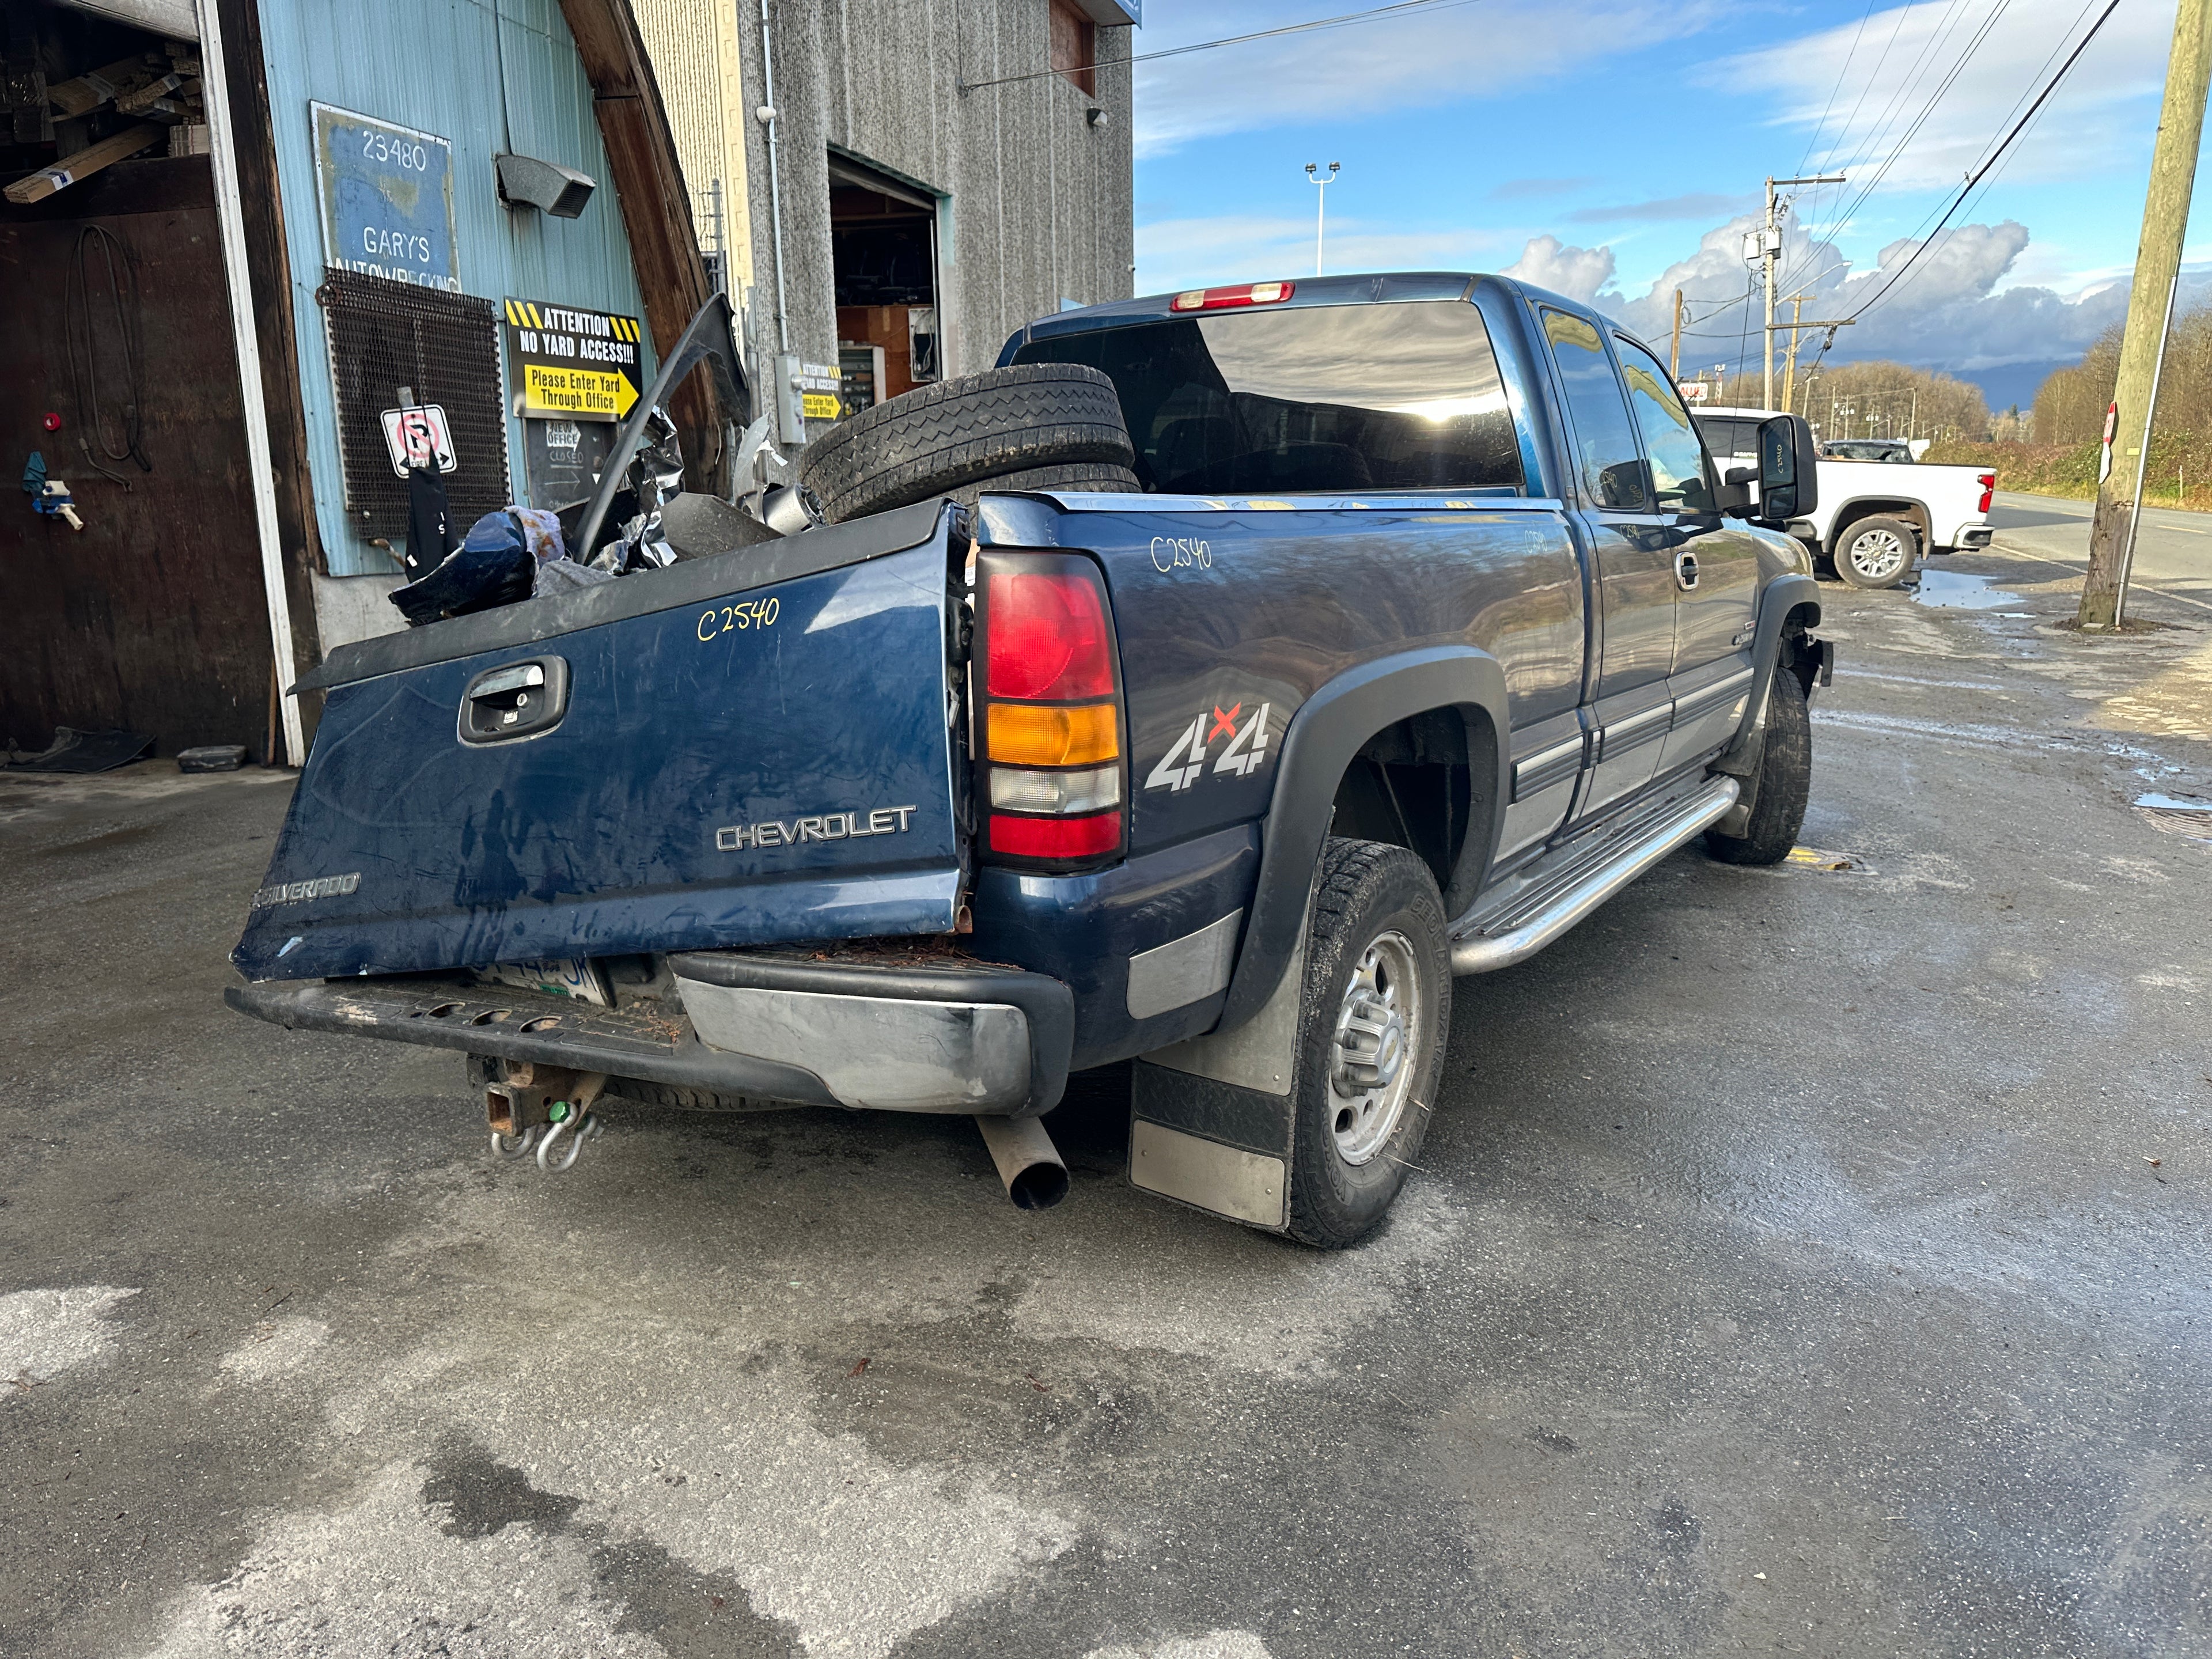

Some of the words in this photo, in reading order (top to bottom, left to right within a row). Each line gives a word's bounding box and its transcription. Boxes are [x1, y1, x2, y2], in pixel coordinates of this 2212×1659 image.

[363, 130, 426, 172] 23480
[363, 226, 430, 263] GARY'S
[544, 307, 610, 338] ATTENTION
[520, 330, 537, 354] NO
[542, 333, 575, 358] YARD
[579, 338, 634, 364] ACCESS!!!
[532, 369, 566, 388] Please
[570, 373, 596, 391] Enter
[599, 376, 620, 393] Yard
[540, 388, 582, 410] Through
[586, 392, 615, 410] Office
[548, 433, 578, 445] OFFICE
[551, 421, 572, 433] NEW
[550, 450, 584, 464] CLOSED
[1150, 536, 1211, 573] C2540
[716, 805, 918, 852] CHEVROLET
